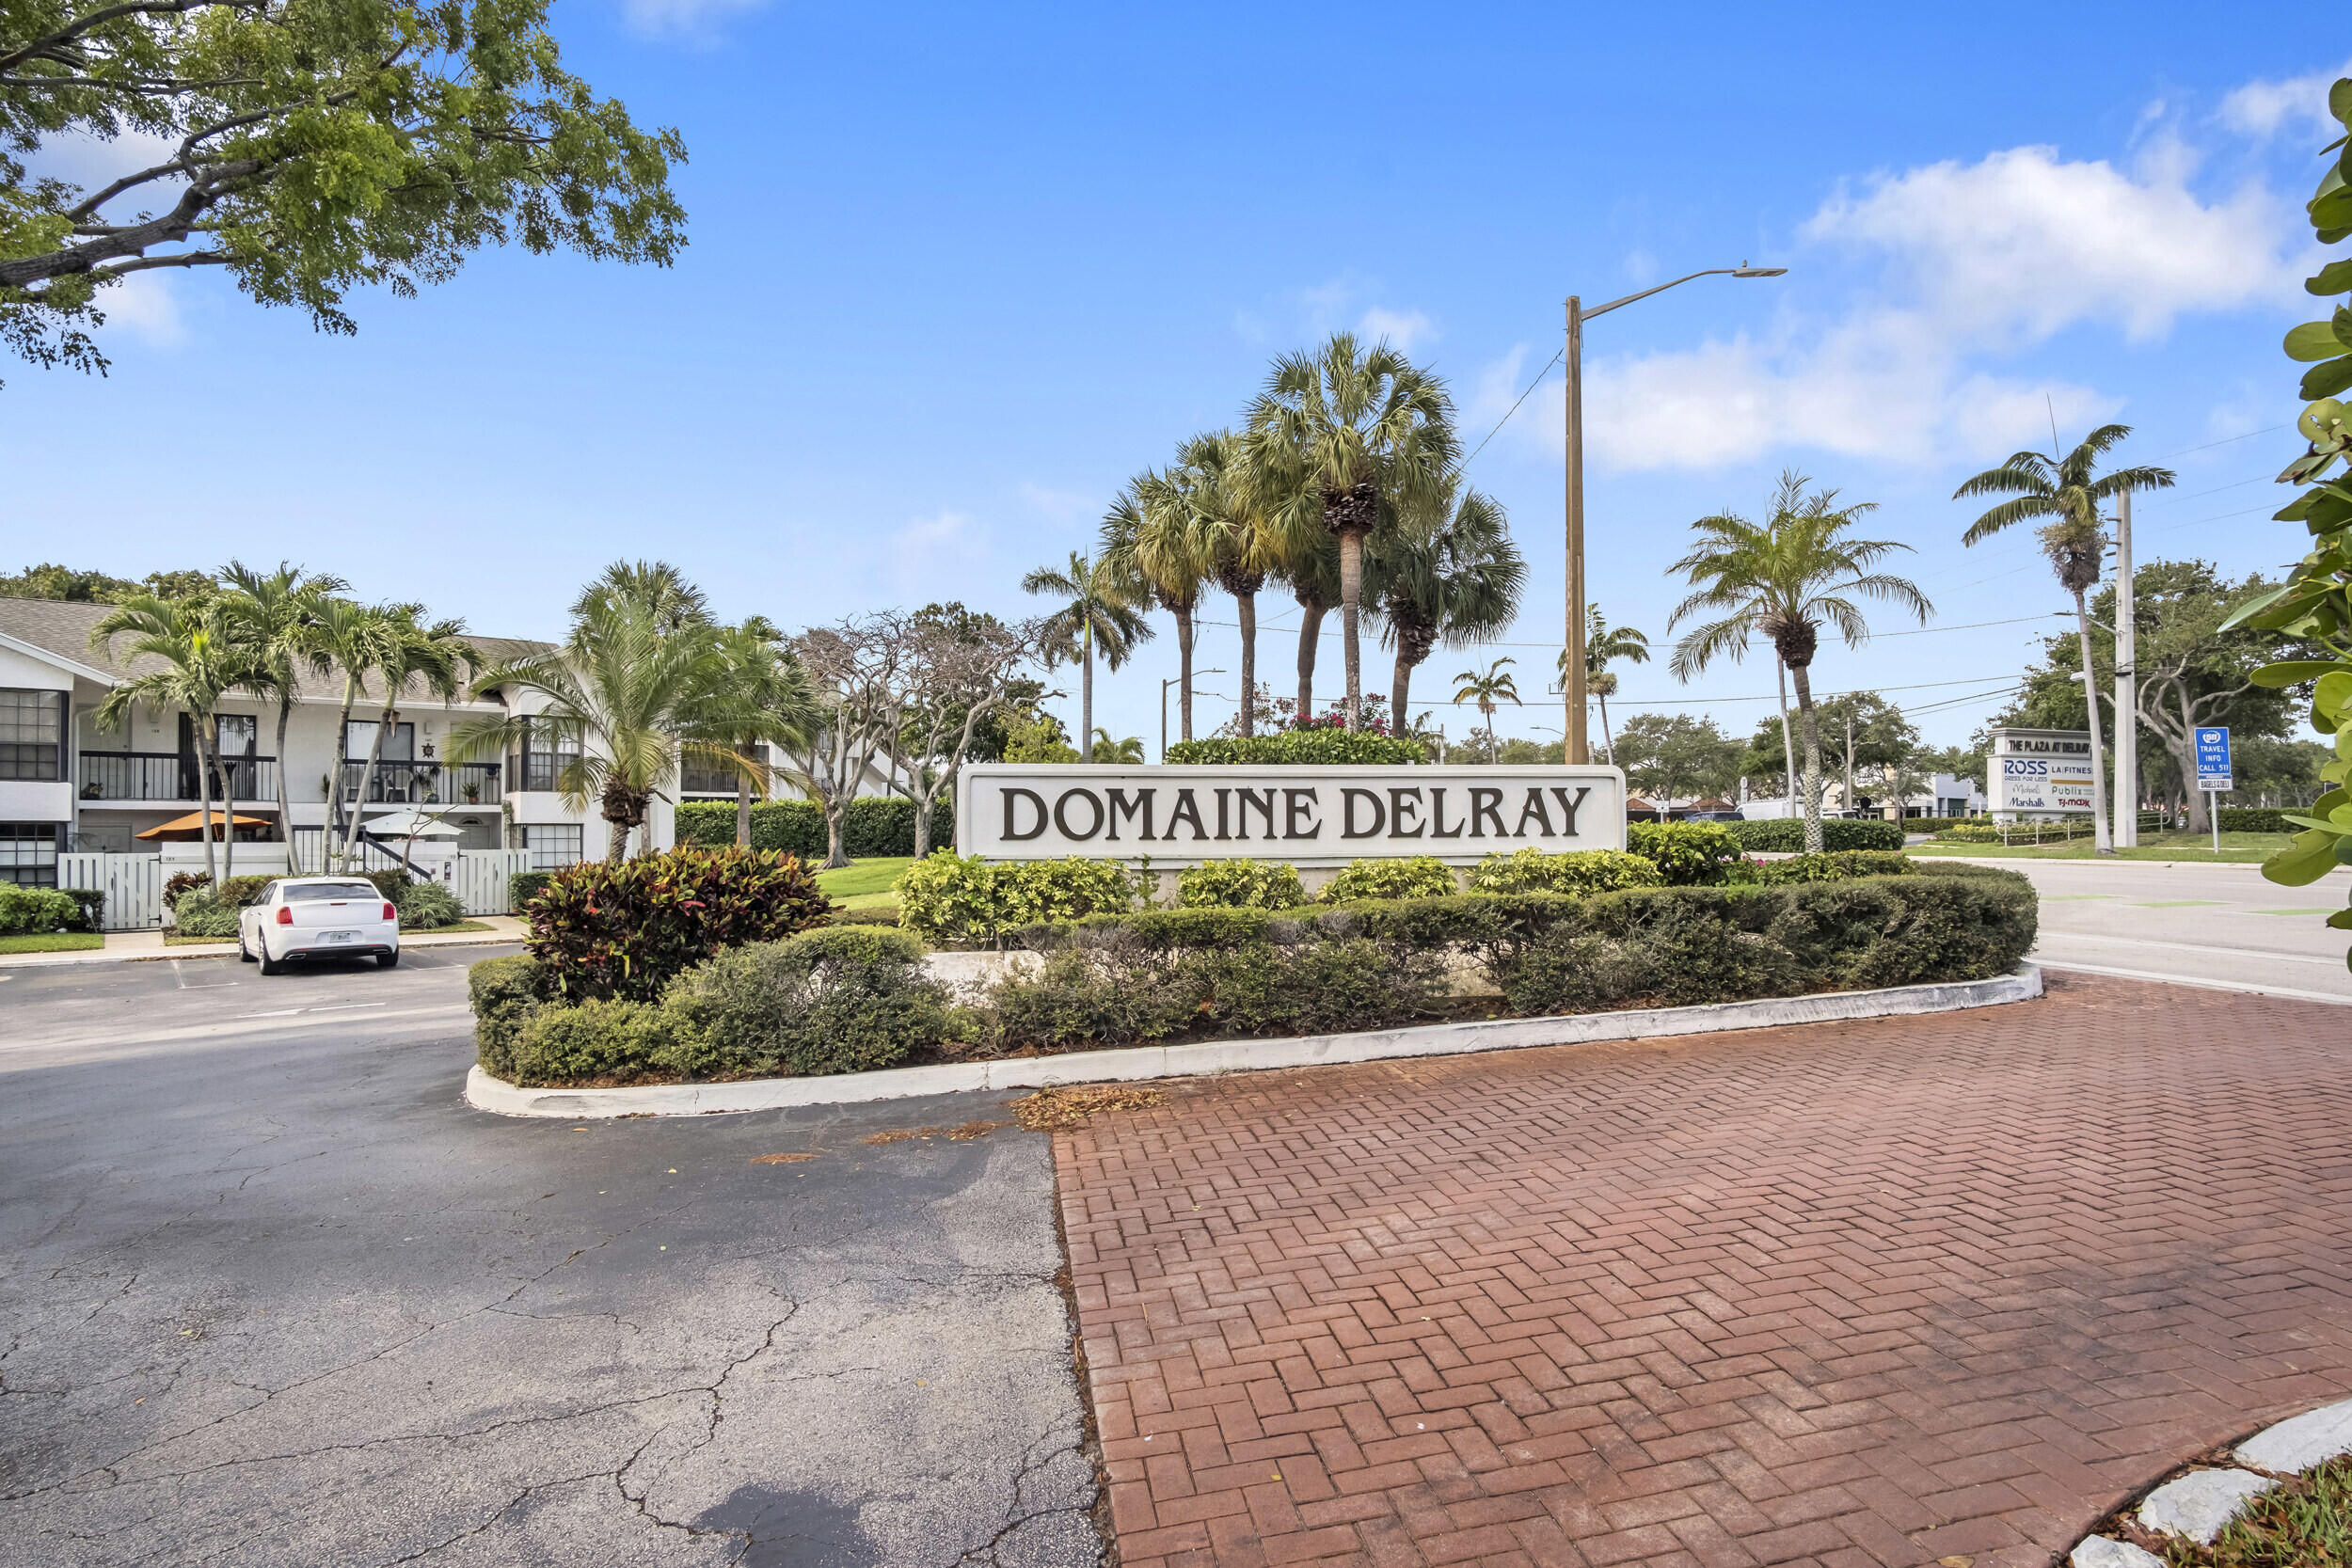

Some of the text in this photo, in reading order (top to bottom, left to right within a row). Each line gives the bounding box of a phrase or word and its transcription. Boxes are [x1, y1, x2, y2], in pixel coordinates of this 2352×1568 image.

[2009, 740, 2023, 752] THE
[2025, 740, 2050, 752] PLAZA
[2052, 741, 2061, 752] AT
[2004, 760, 2047, 775] ROSS
[2052, 785, 2082, 796] Publix
[2010, 798, 2045, 808] Marshalls
[999, 786, 1592, 842] DOMAINE DELRAY
